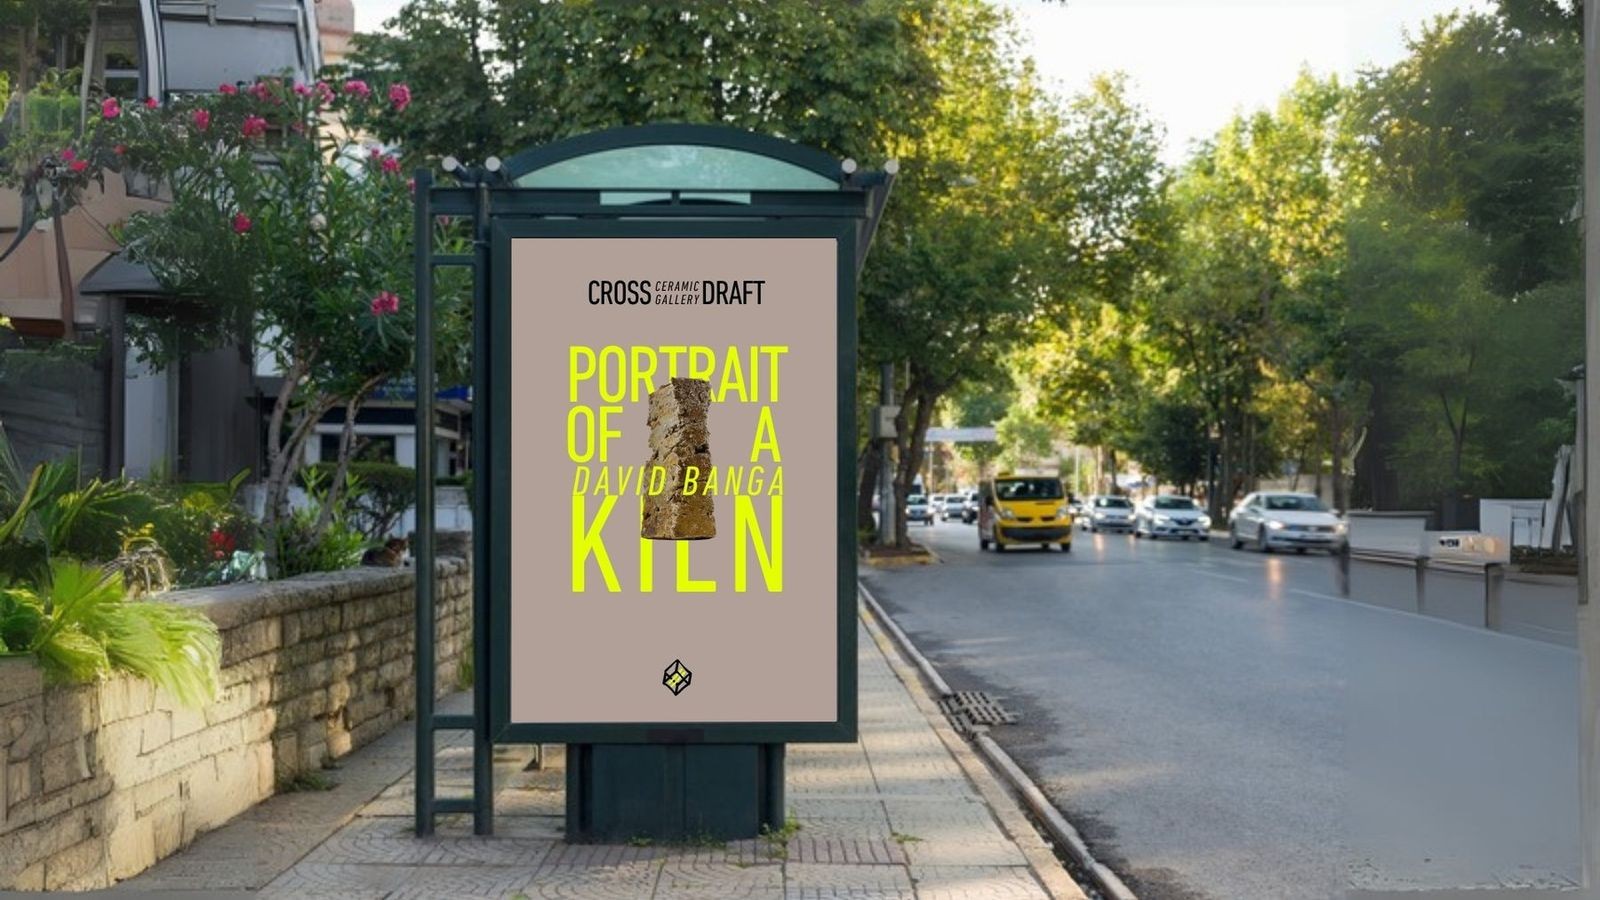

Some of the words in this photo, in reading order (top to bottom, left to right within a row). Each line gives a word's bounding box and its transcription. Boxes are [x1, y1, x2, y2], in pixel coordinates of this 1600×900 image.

[588, 279, 651, 305] CROSS
[655, 281, 700, 292] CERAMIC
[655, 294, 700, 305] GALLERY
[702, 280, 766, 305] DRAFT
[569, 345, 789, 403] PORTRAIT
[567, 405, 624, 463] OF
[750, 405, 782, 463] A
[572, 465, 667, 496] DAVID
[682, 465, 784, 496] BANGA
